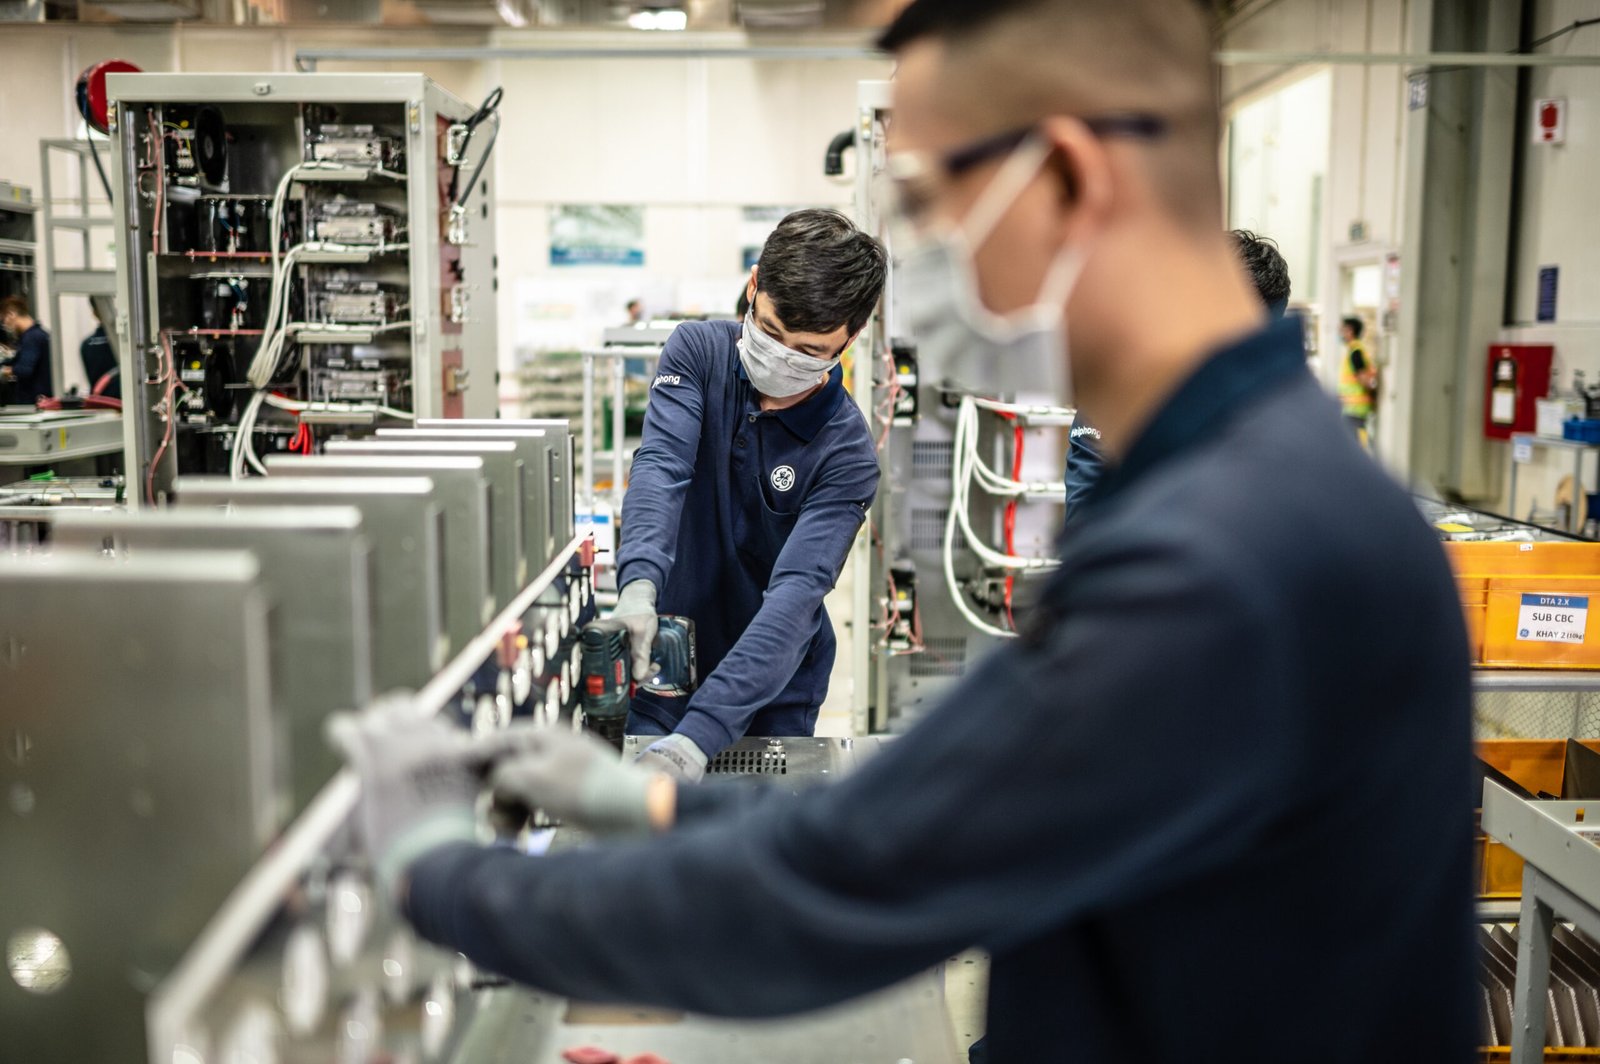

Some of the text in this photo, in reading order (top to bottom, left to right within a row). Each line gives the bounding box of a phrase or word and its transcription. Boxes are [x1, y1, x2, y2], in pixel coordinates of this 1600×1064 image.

[1540, 597, 1569, 606] DTA 2.X
[1532, 613, 1574, 623] SUB CBC
[1536, 630, 1558, 638] KHAY
